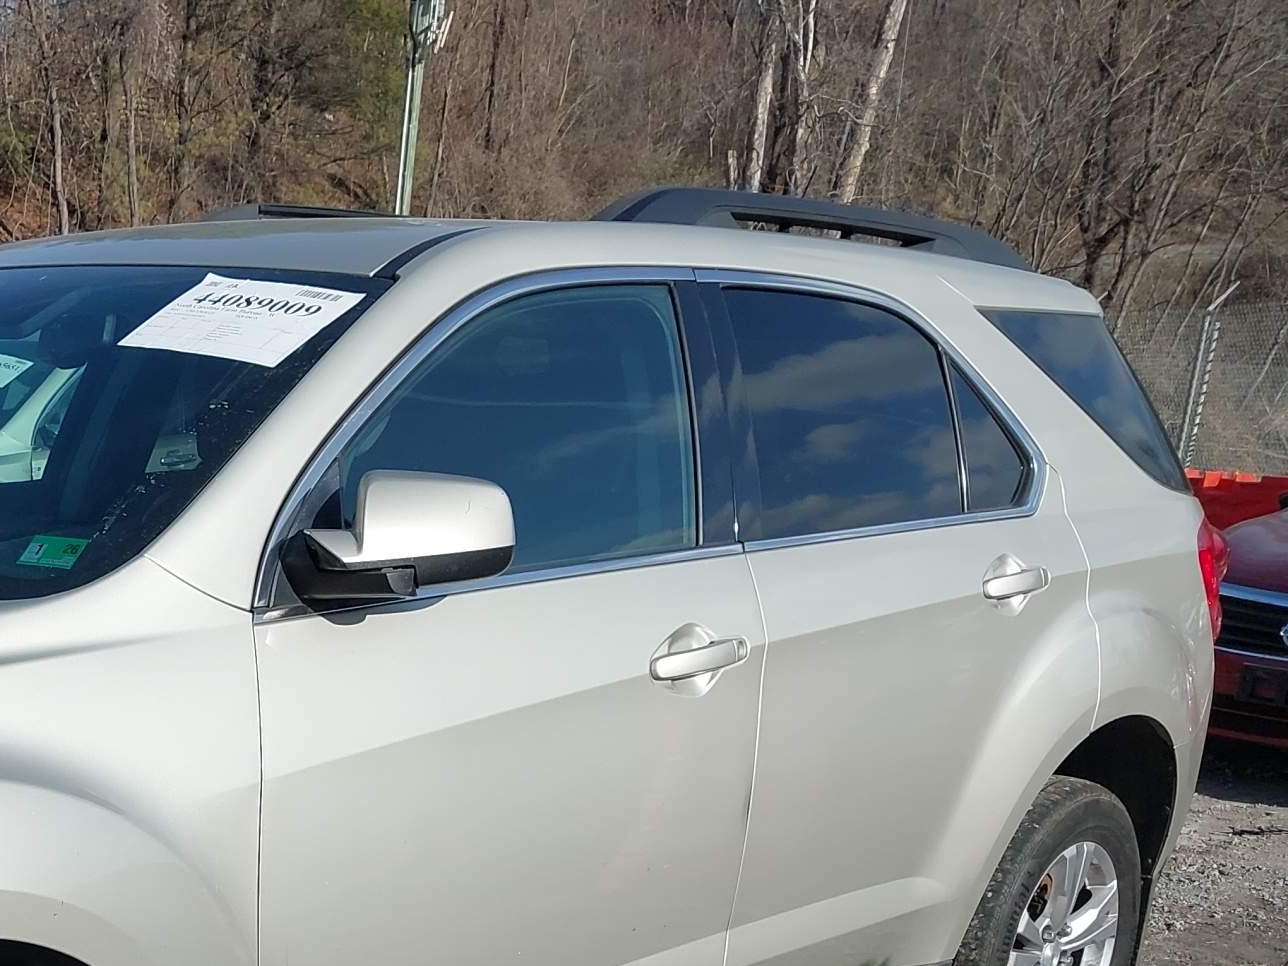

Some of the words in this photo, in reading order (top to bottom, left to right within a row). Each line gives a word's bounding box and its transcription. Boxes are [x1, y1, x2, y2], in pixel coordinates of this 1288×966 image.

[192, 291, 323, 317] 44089009
[34, 543, 45, 556] 1
[63, 543, 81, 555] 26
